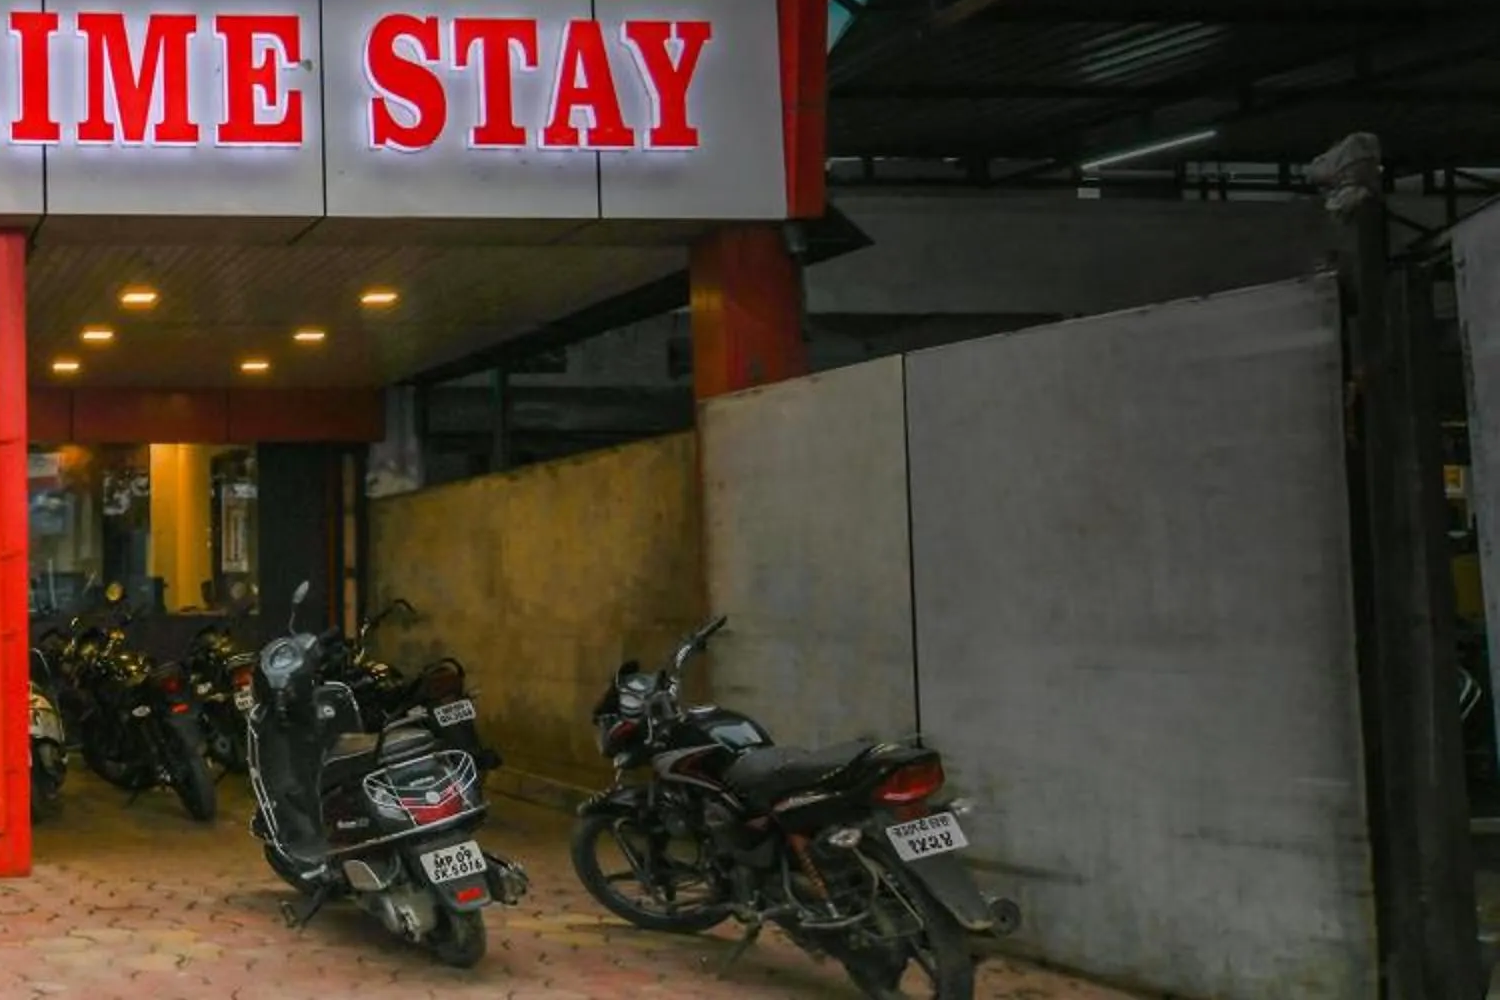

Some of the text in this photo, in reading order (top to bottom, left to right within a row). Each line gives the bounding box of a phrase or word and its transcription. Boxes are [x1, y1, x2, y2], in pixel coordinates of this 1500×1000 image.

[366, 12, 712, 153] STAY
[434, 849, 472, 868] MP 09
